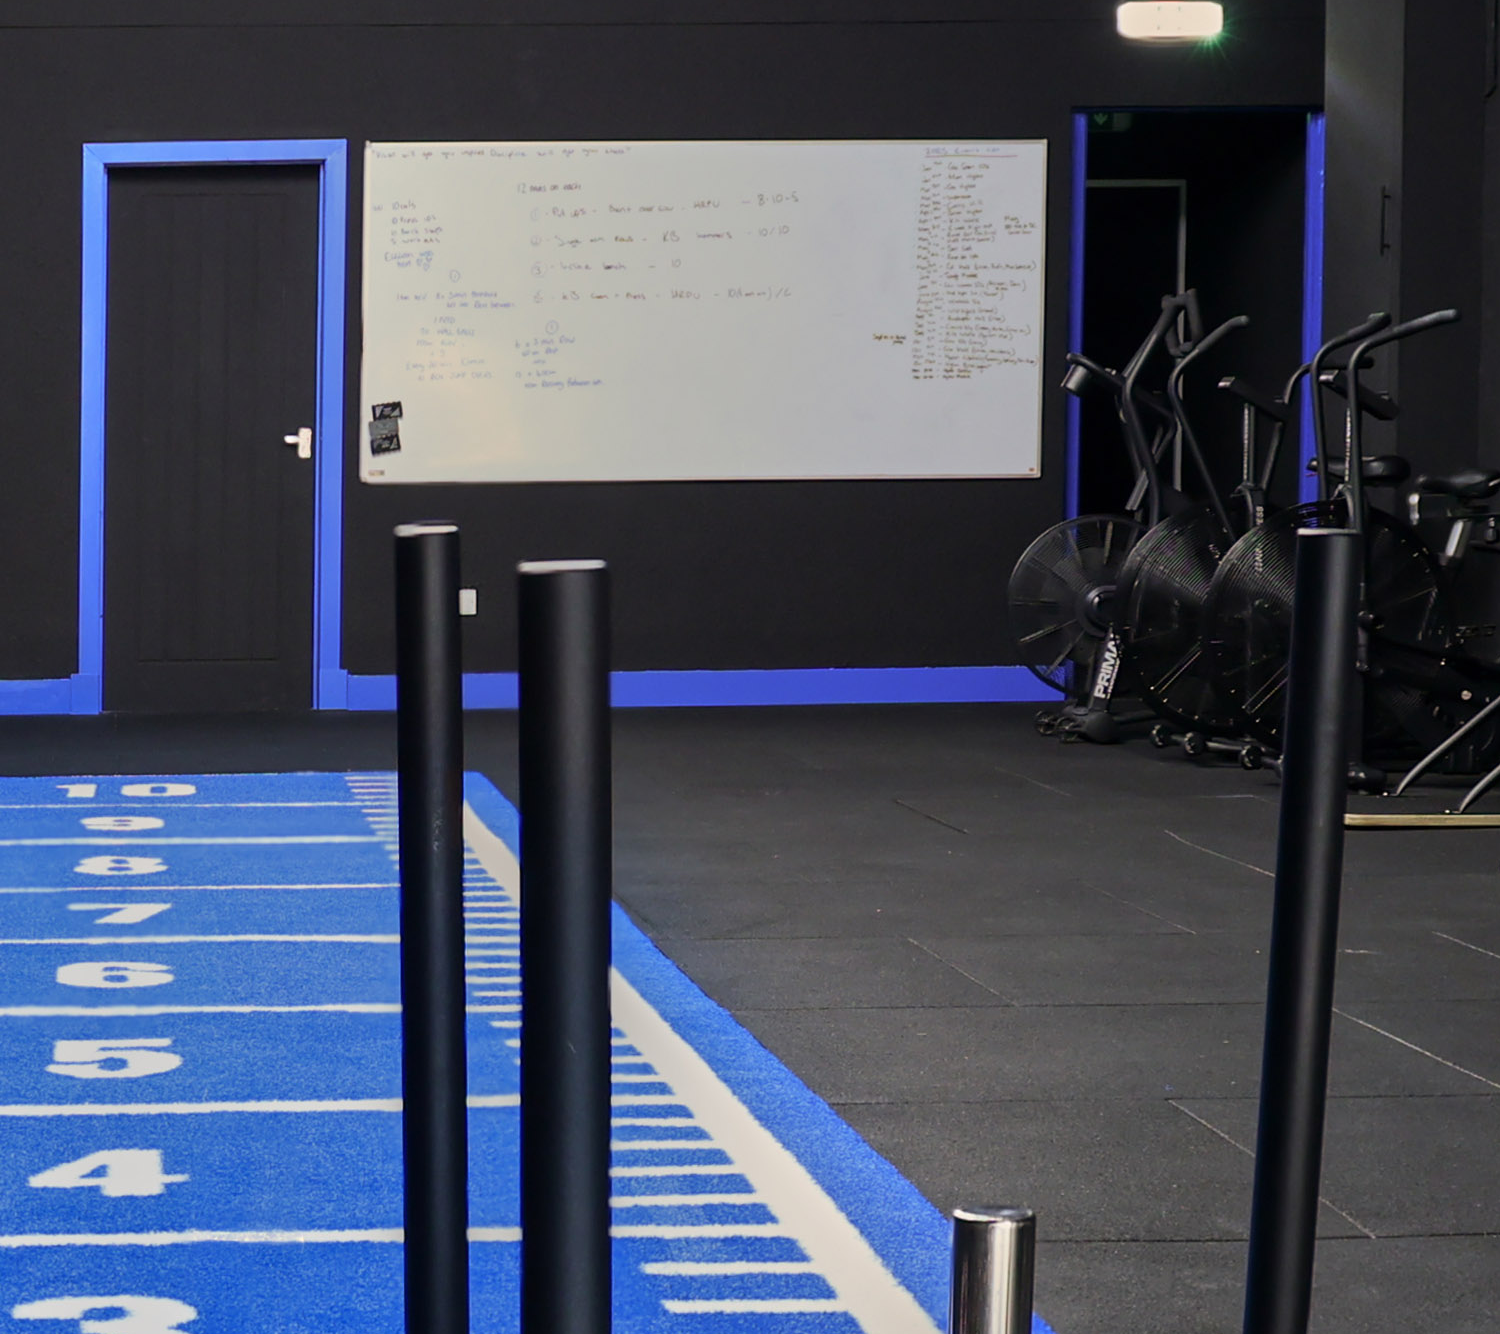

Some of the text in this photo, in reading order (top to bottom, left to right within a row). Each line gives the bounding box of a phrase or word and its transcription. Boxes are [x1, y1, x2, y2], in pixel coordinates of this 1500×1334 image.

[1093, 640, 1119, 699] PRIMA
[57, 783, 196, 799] 10
[80, 815, 165, 832] 9
[73, 855, 168, 876] 8
[67, 902, 172, 924] 7
[55, 961, 175, 989] 6
[46, 1038, 183, 1079] 5
[28, 1148, 189, 1198] 4
